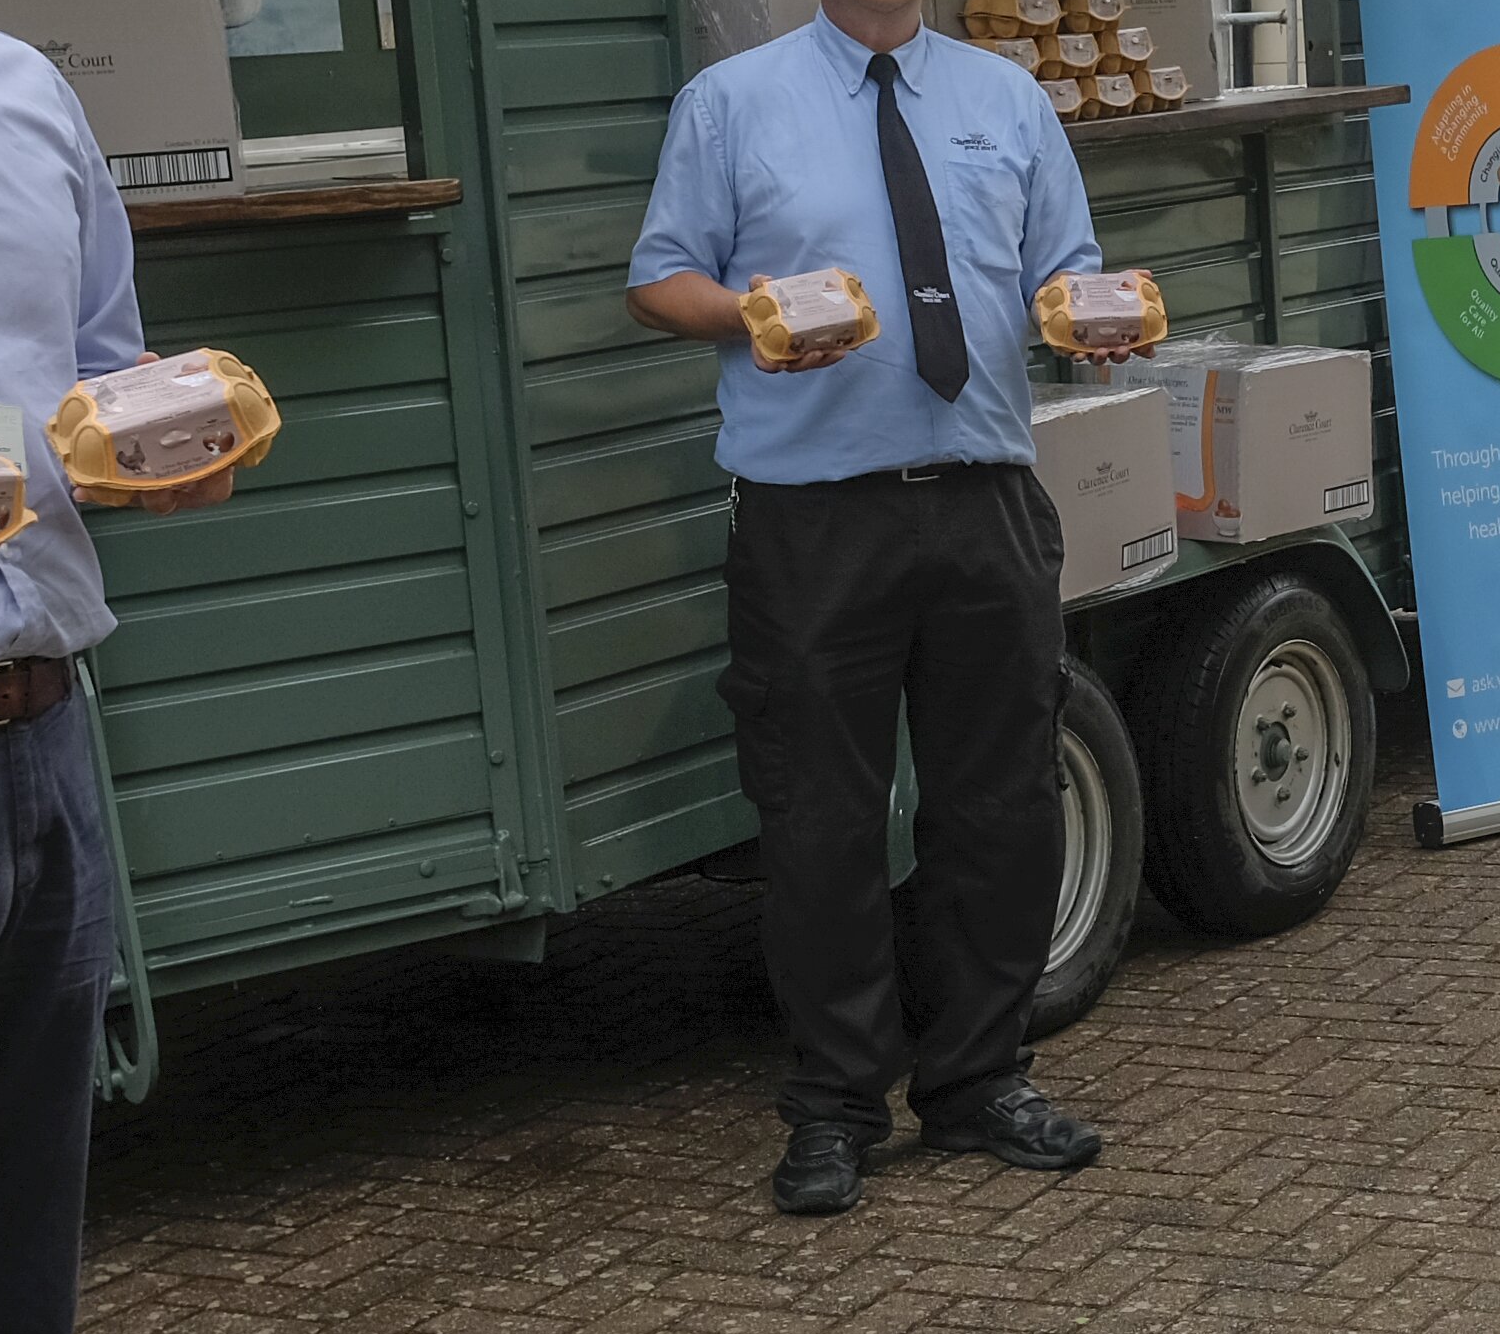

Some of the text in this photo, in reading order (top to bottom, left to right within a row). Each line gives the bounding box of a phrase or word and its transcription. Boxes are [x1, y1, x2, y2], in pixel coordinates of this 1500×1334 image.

[68, 54, 113, 68] Court
[1431, 84, 1472, 145] Adapting in
[1441, 95, 1479, 154] a Changing
[1447, 102, 1489, 162] Community
[1469, 305, 1486, 326] Care
[1471, 289, 1498, 322] Quality
[1460, 311, 1485, 339] for All
[1216, 405, 1232, 415] MW
[1289, 423, 1314, 435] Clarence
[1315, 419, 1332, 429] Court
[1432, 445, 1500, 470] Through
[1078, 475, 1109, 491] Clarence
[1110, 468, 1130, 481] Court
[1441, 483, 1500, 508] helping
